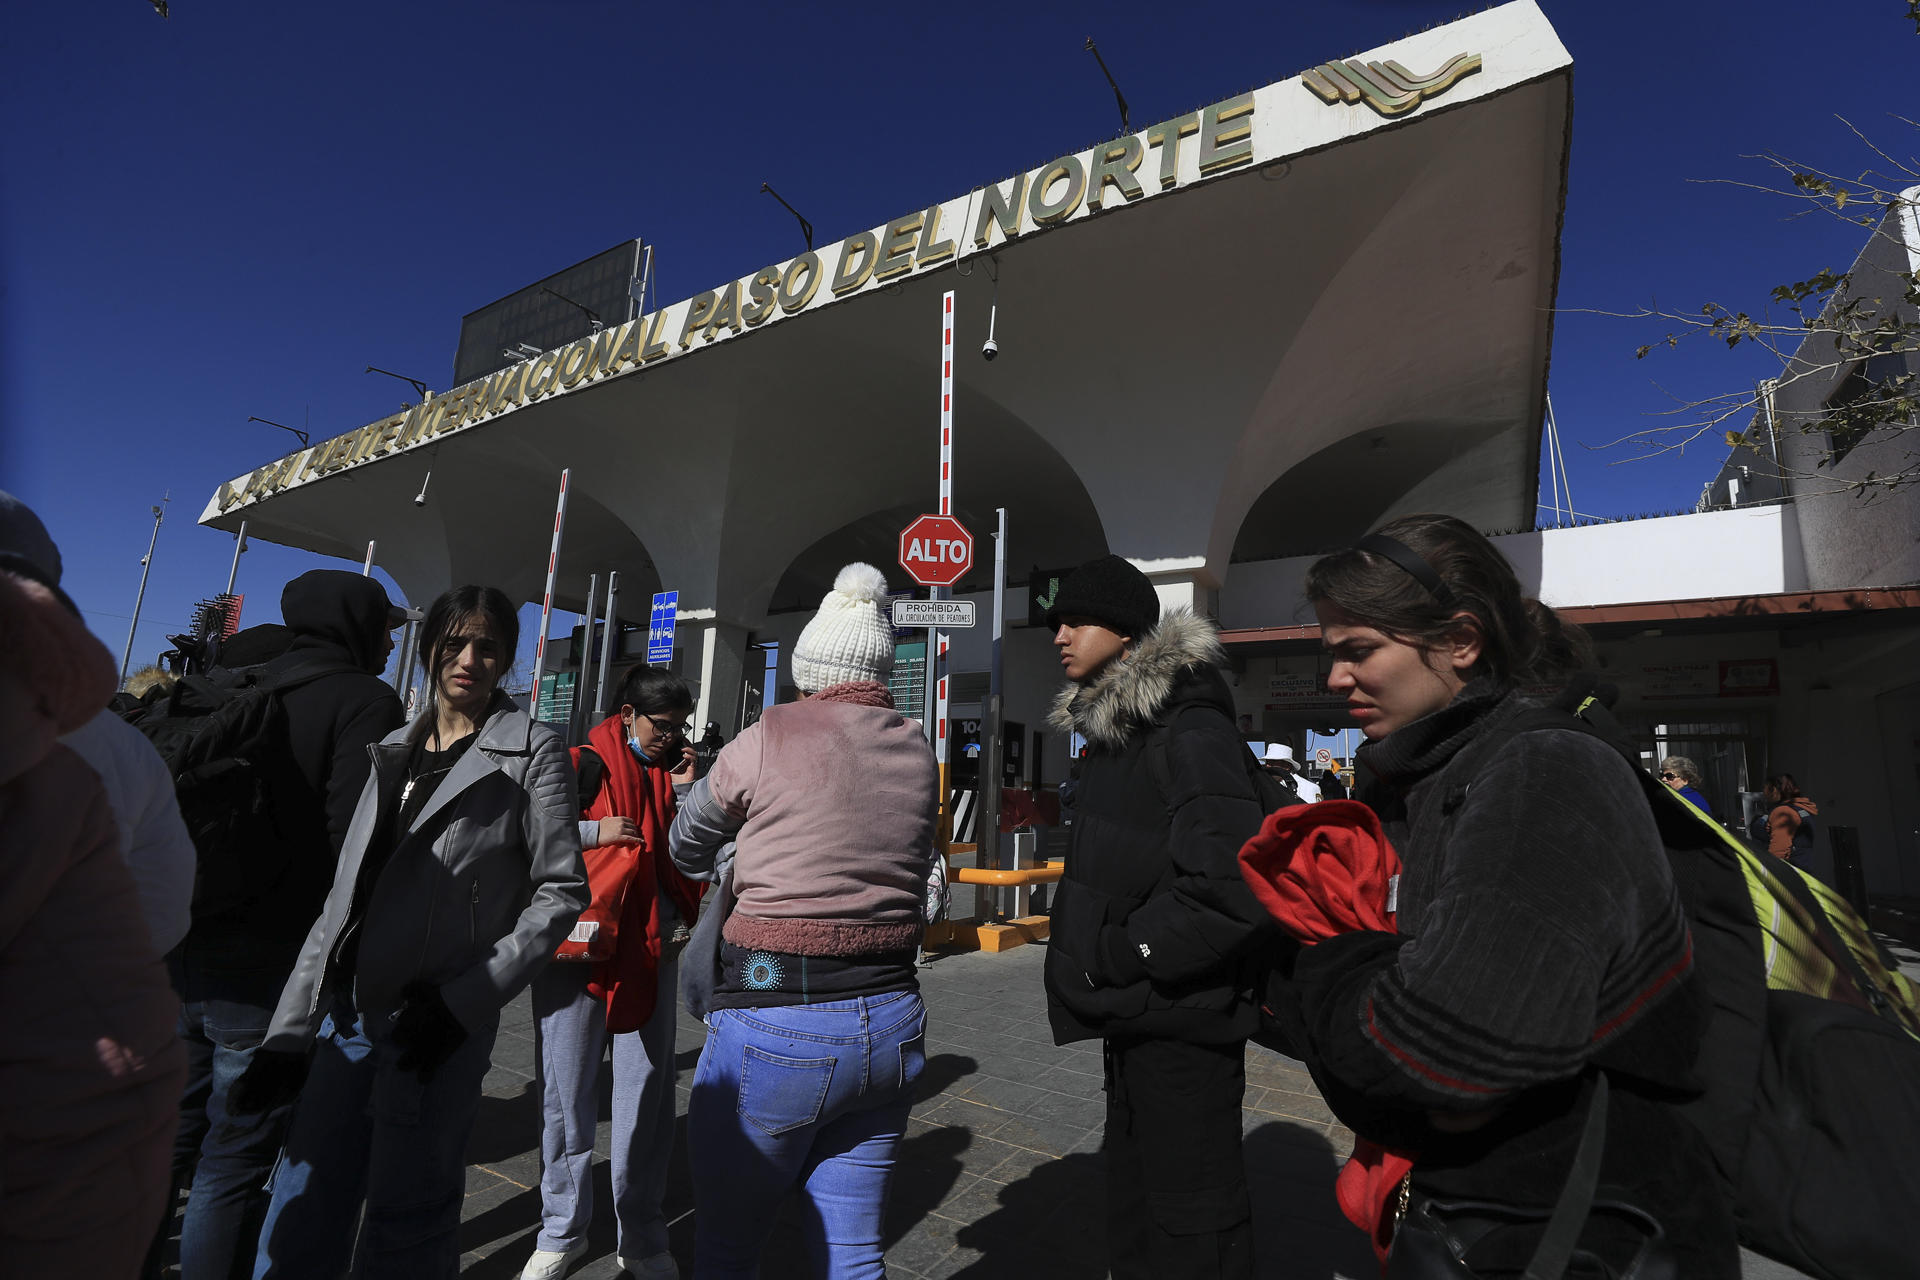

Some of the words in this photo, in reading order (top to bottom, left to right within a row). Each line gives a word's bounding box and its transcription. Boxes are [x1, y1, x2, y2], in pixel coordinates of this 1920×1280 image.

[395, 311, 670, 449] INTERNACIONAL
[678, 252, 824, 349] PASO
[830, 206, 956, 298] DEL
[974, 92, 1256, 248] NORTE
[906, 538, 967, 564] ALTO
[906, 604, 962, 613] PROHIBIDA
[897, 614, 904, 622] LA
[939, 614, 945, 622] DE
[947, 615, 971, 623] PEATONES
